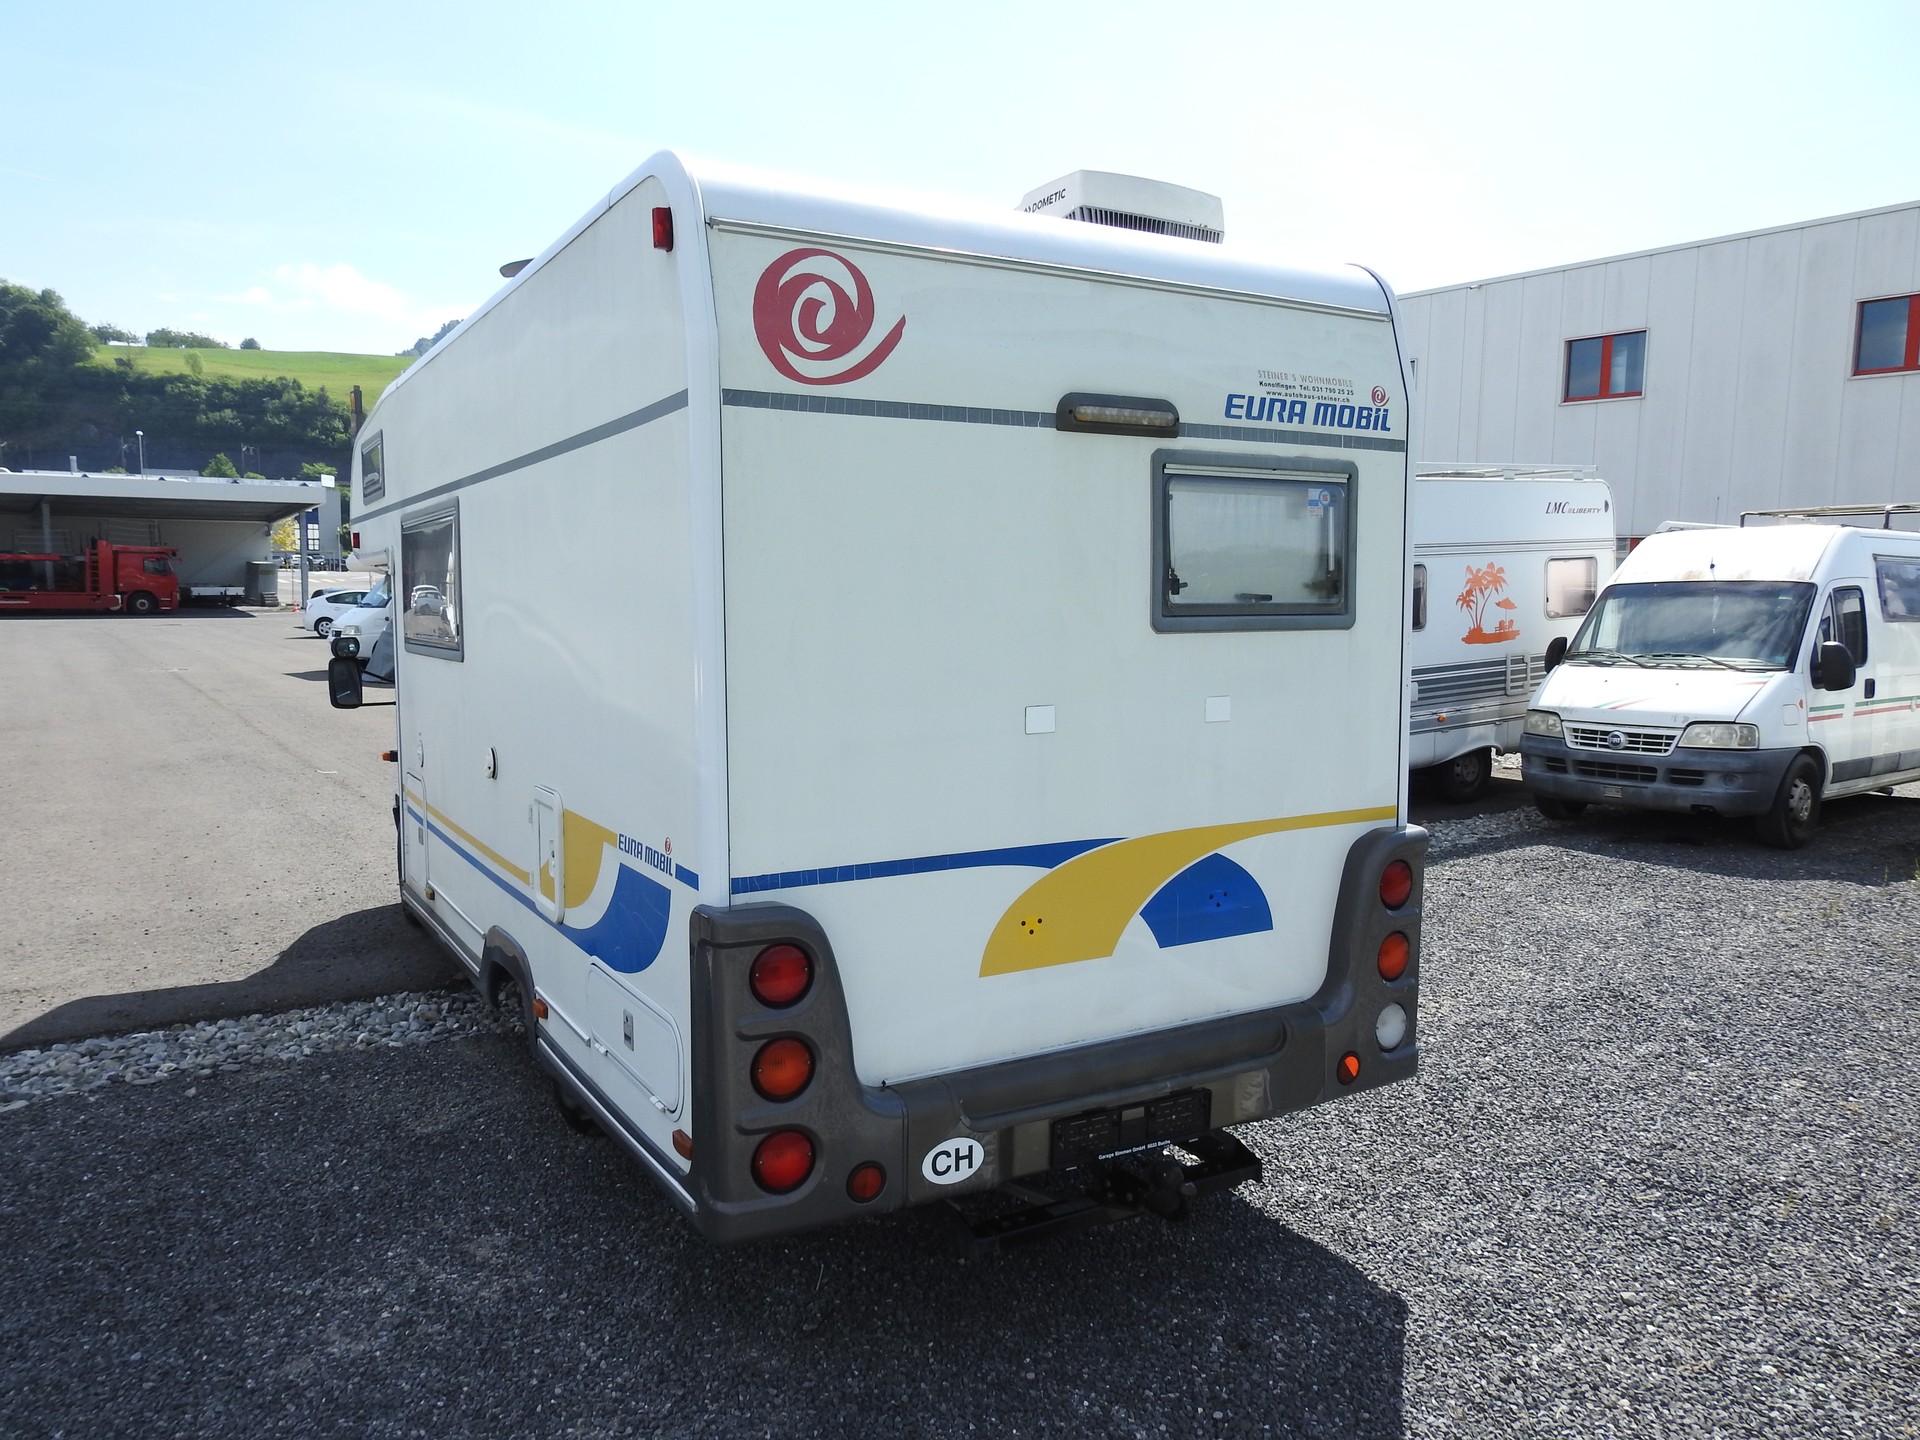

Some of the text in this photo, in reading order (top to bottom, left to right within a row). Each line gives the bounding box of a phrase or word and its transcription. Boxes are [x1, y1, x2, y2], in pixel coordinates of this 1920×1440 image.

[1032, 188, 1066, 213] DOMETIC
[1259, 381, 1296, 390] Konolfingen
[1300, 375, 1353, 388] WOHNMOBILE
[1266, 390, 1350, 403] www.autohaus-steiner.ch
[1225, 393, 1307, 425] EURA
[1545, 501, 1569, 514] LMC
[619, 833, 673, 876] EURA MOBIL
[931, 1144, 973, 1177] CH
